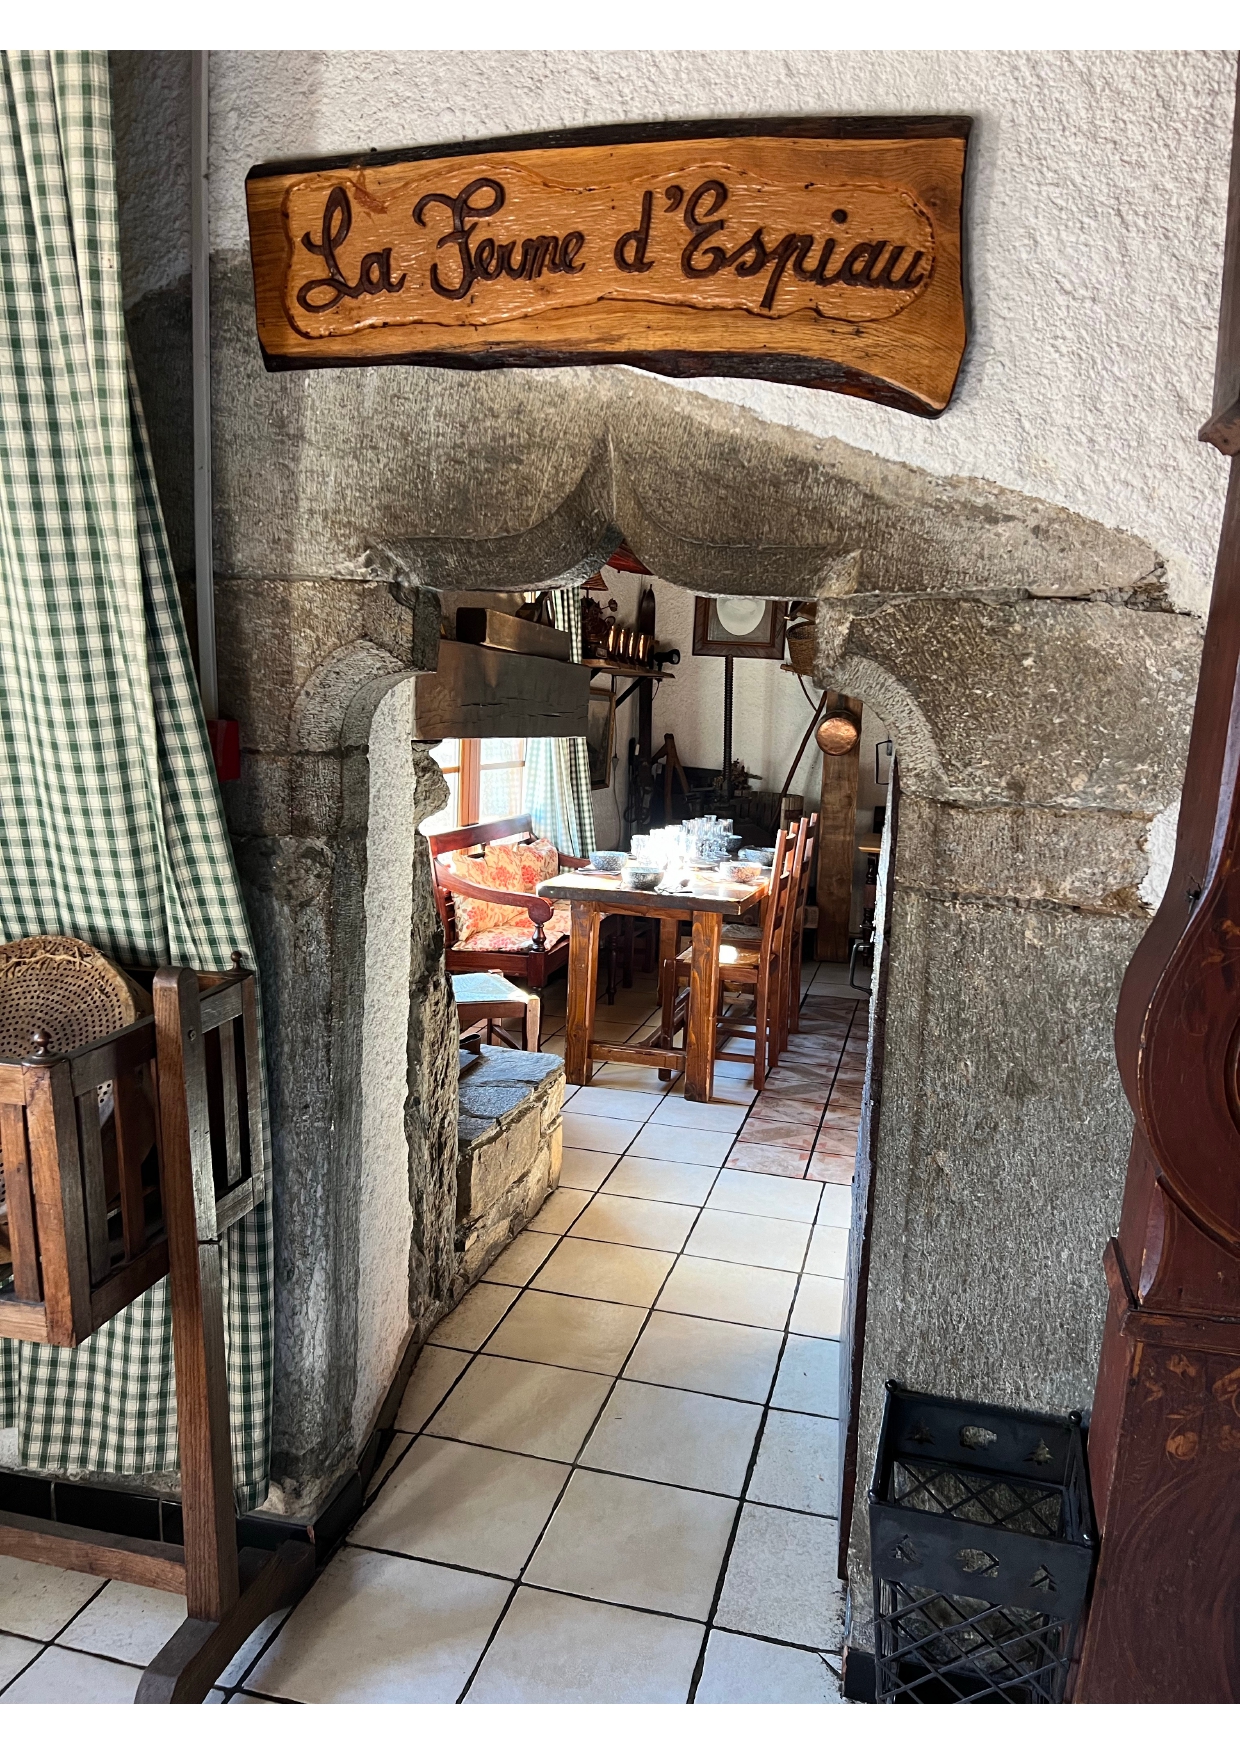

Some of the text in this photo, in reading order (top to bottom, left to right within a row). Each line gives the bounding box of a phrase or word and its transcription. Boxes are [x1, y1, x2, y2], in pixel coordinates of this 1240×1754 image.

[297, 178, 926, 313] La Ferme d'Espiau
